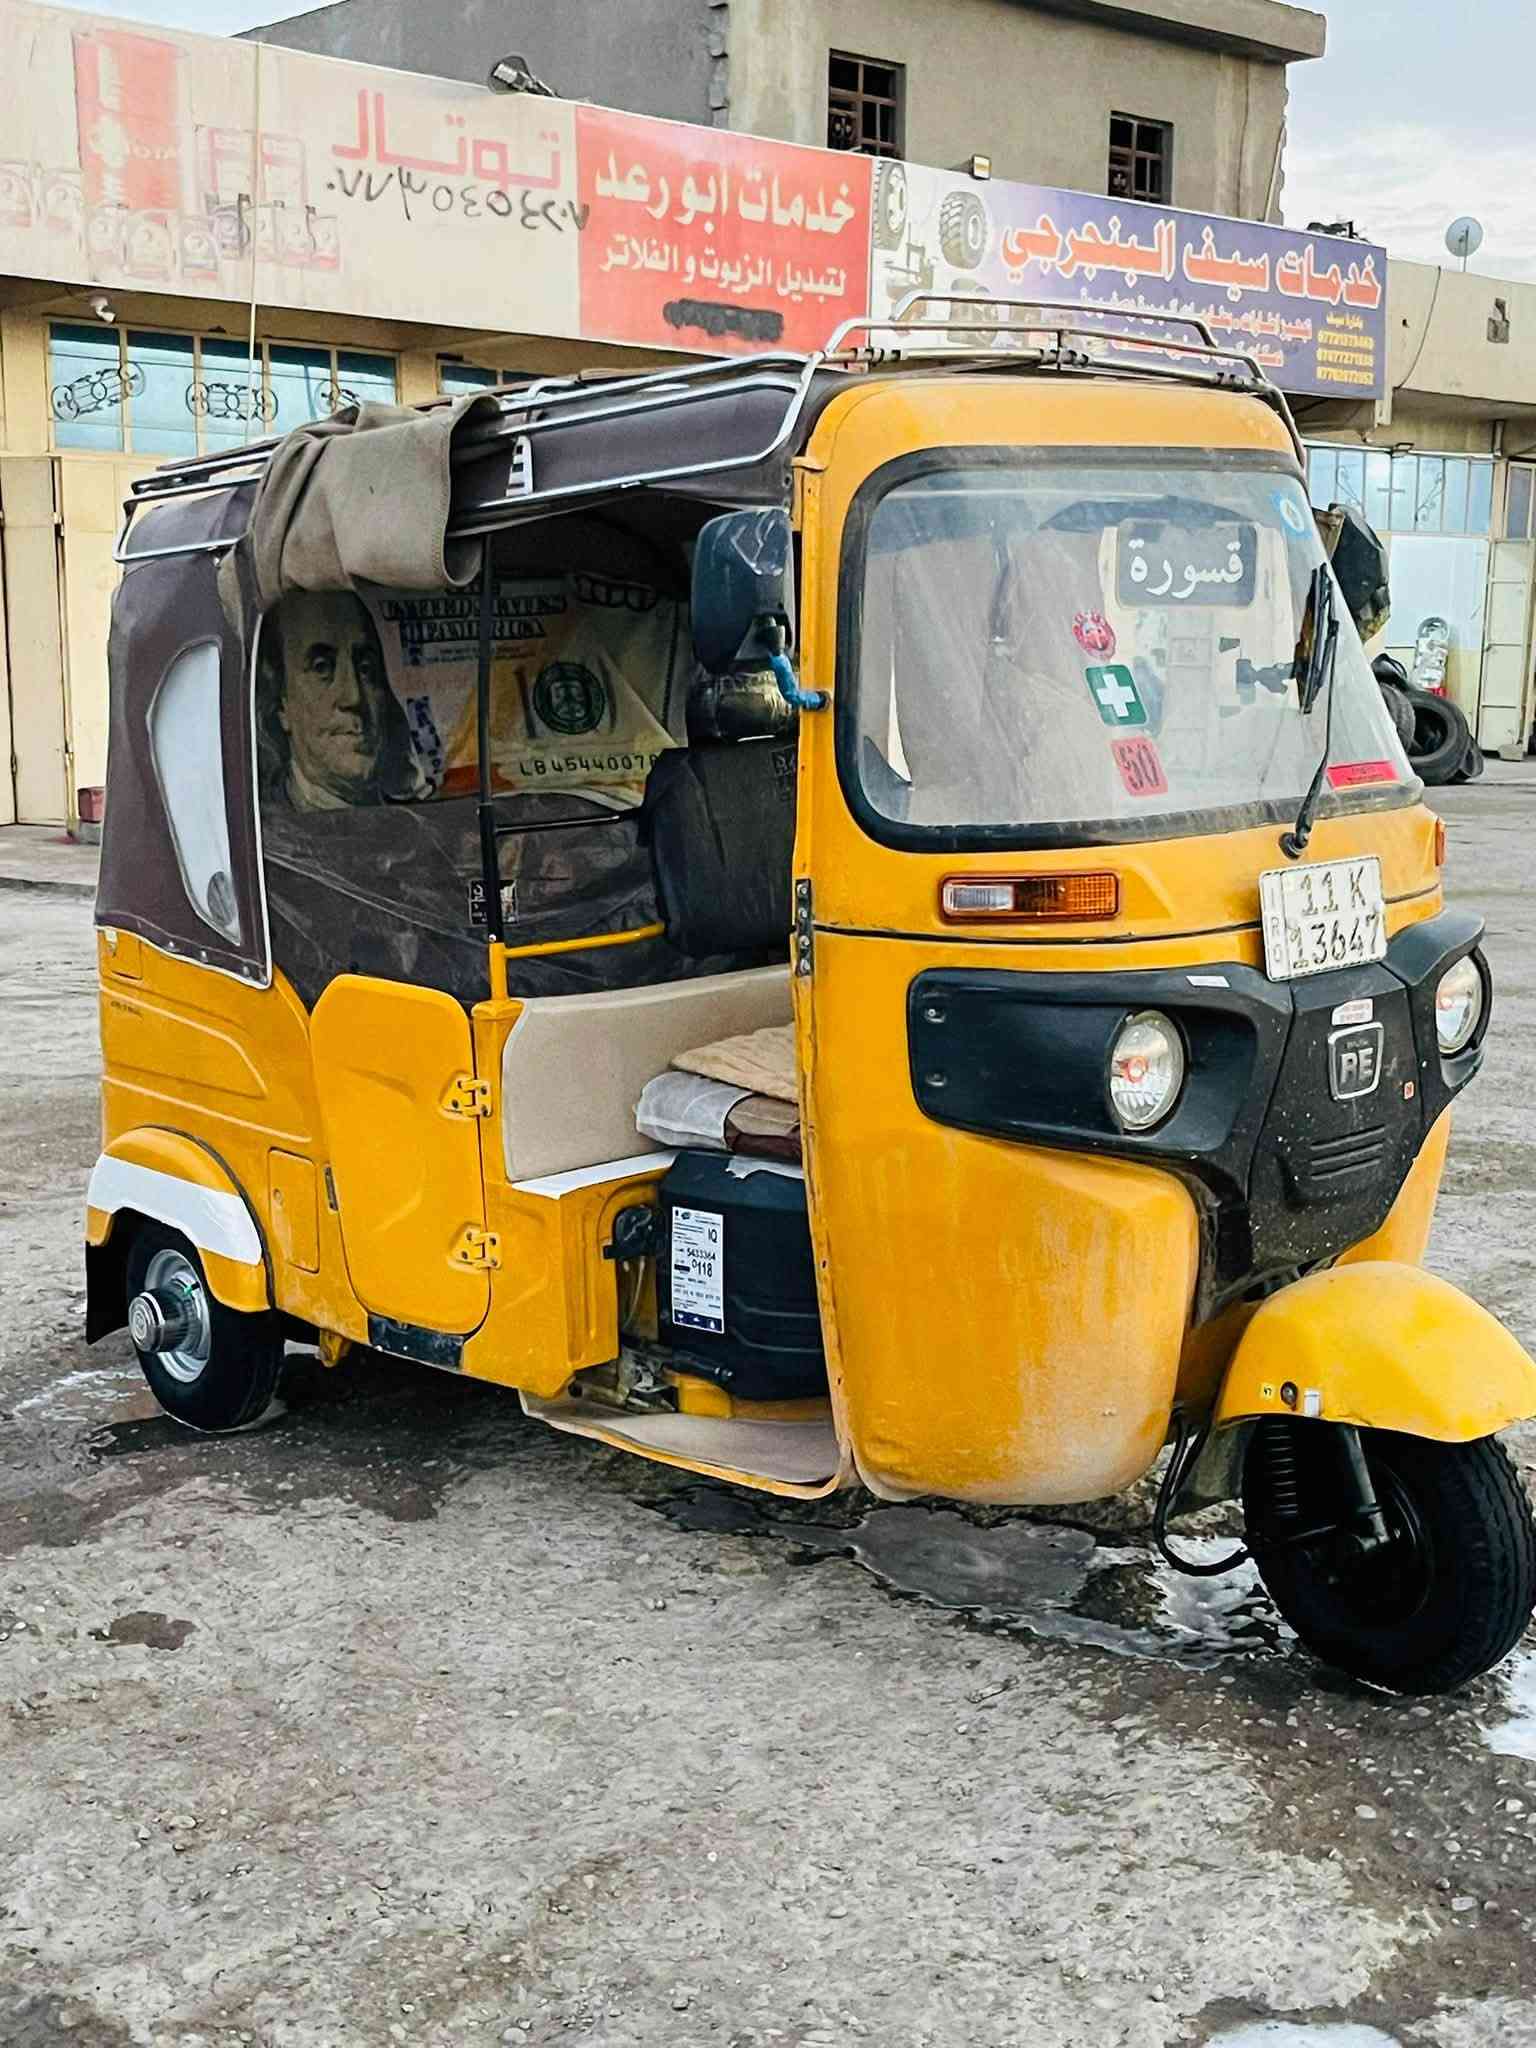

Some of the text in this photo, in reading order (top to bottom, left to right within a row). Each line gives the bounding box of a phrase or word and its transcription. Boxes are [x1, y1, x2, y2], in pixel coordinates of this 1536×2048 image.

[331, 88, 562, 193] توتال
[737, 167, 856, 235] خدمات
[599, 232, 847, 304] لتبديل الزيوت و الفلاتر
[1001, 213, 1177, 285] البنجرجي
[1182, 224, 1270, 303] سيف
[1275, 242, 1382, 310] خدمات
[1127, 537, 1244, 600] قسورة
[1300, 865, 1366, 917] 11 K
[1288, 908, 1380, 970] 13647
[1340, 1046, 1375, 1085] RE
